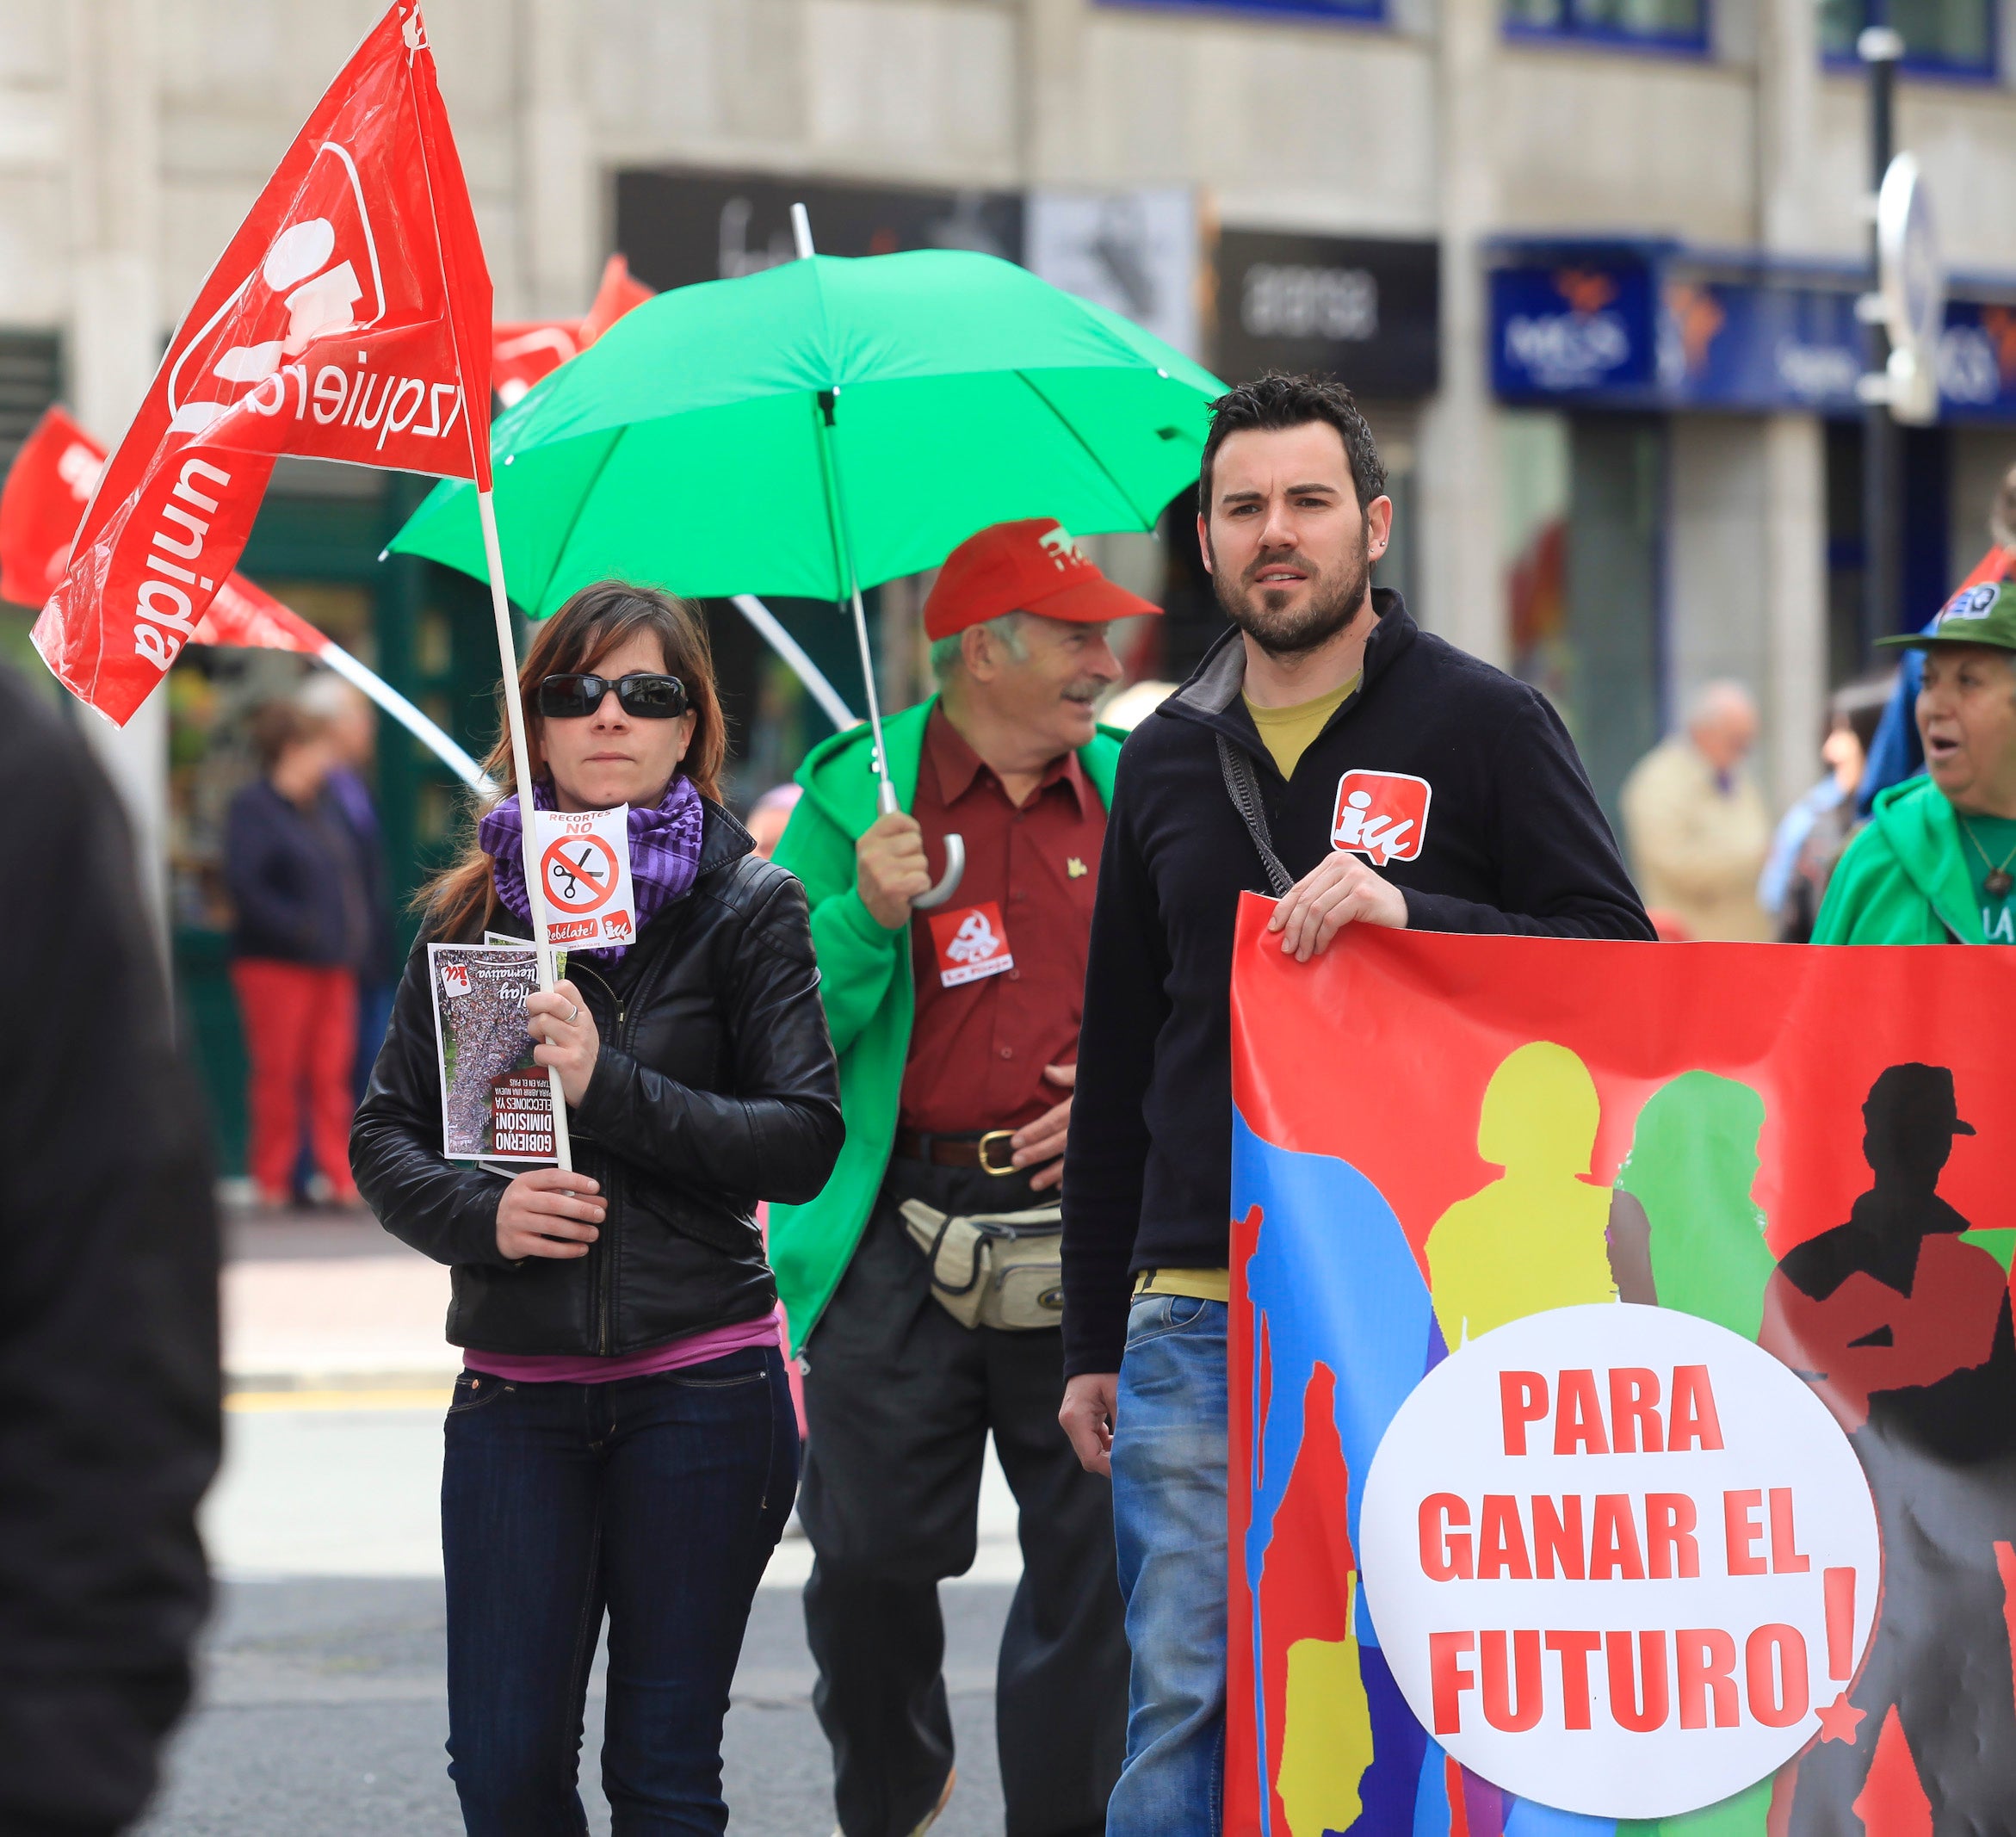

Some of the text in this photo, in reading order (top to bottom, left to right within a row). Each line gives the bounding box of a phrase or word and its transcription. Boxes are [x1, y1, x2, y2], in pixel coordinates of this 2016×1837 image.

[133, 458, 232, 672] unida
[549, 811, 612, 822] RECORTES
[1333, 790, 1415, 855] iu
[566, 822, 593, 834] NO
[498, 982, 529, 1008] Hay
[536, 1079, 552, 1088] TAPA
[495, 1097, 553, 1111] ELECCIONES YA
[496, 1112, 553, 1133] DIMISIÓN!
[496, 1132, 553, 1153] GOBIERNO
[1499, 1364, 1725, 1457] PARA
[1418, 1488, 1811, 1582] GANAR EL
